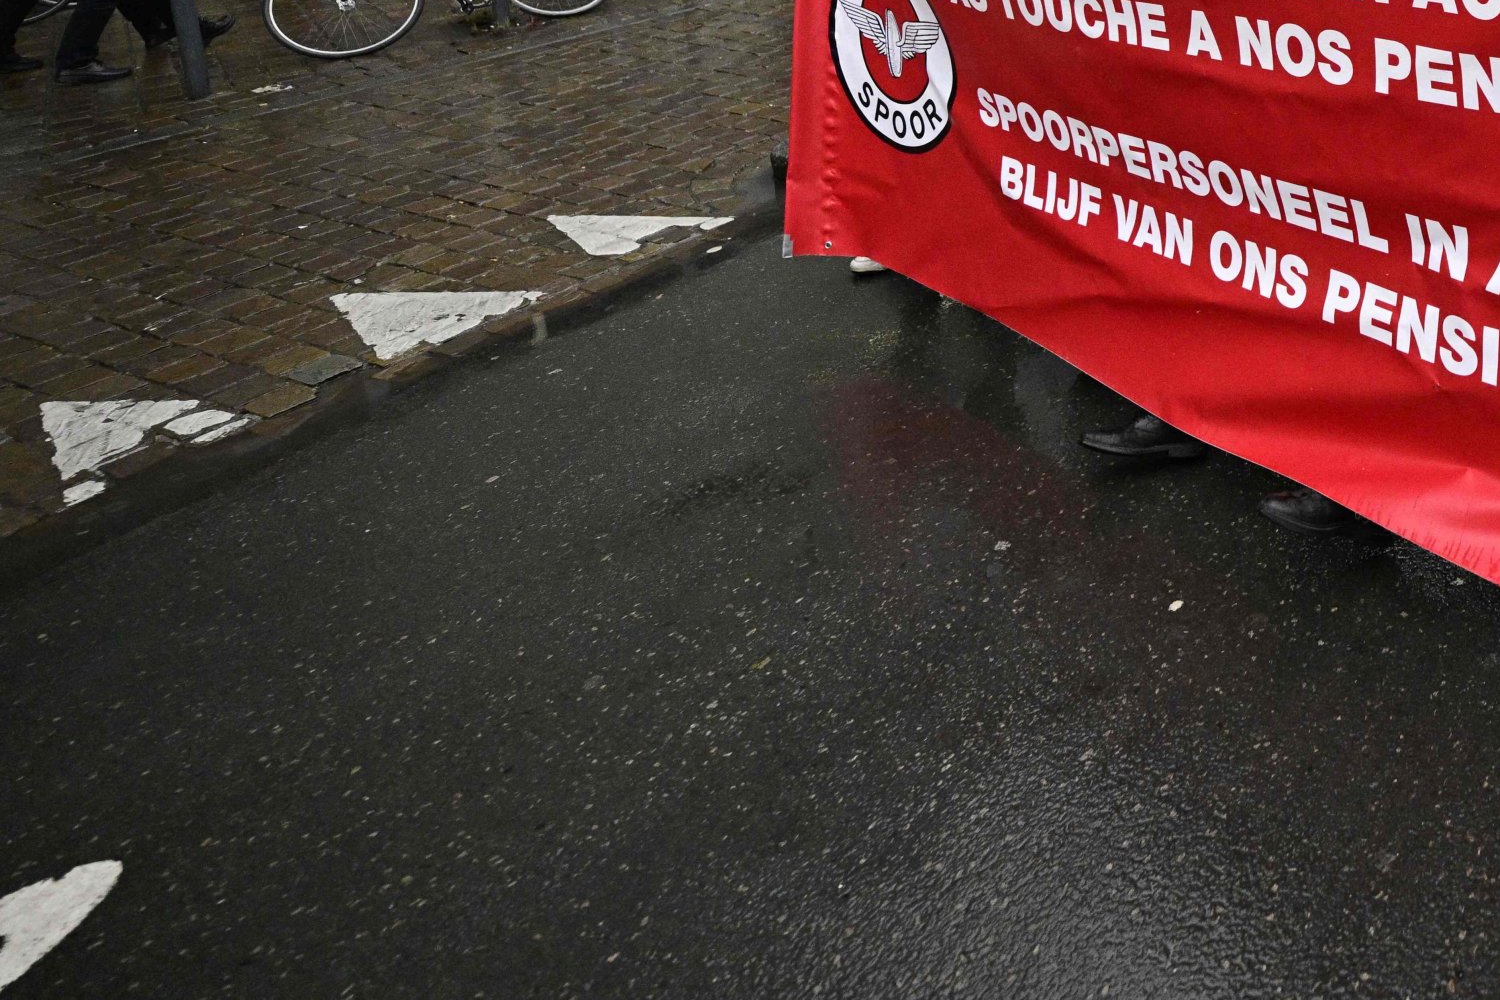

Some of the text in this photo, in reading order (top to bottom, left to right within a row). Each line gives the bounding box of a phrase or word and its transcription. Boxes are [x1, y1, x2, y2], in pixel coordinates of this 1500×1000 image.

[1186, 9, 1223, 61] A
[1235, 15, 1354, 86] NOS
[857, 81, 943, 140] SPOOR
[976, 87, 1390, 254] SPOORPERSONEEL
[1404, 212, 1469, 282] IN
[1000, 155, 1102, 227] BLIJF
[1111, 193, 1194, 266] VAN
[1209, 230, 1310, 309] ONS
